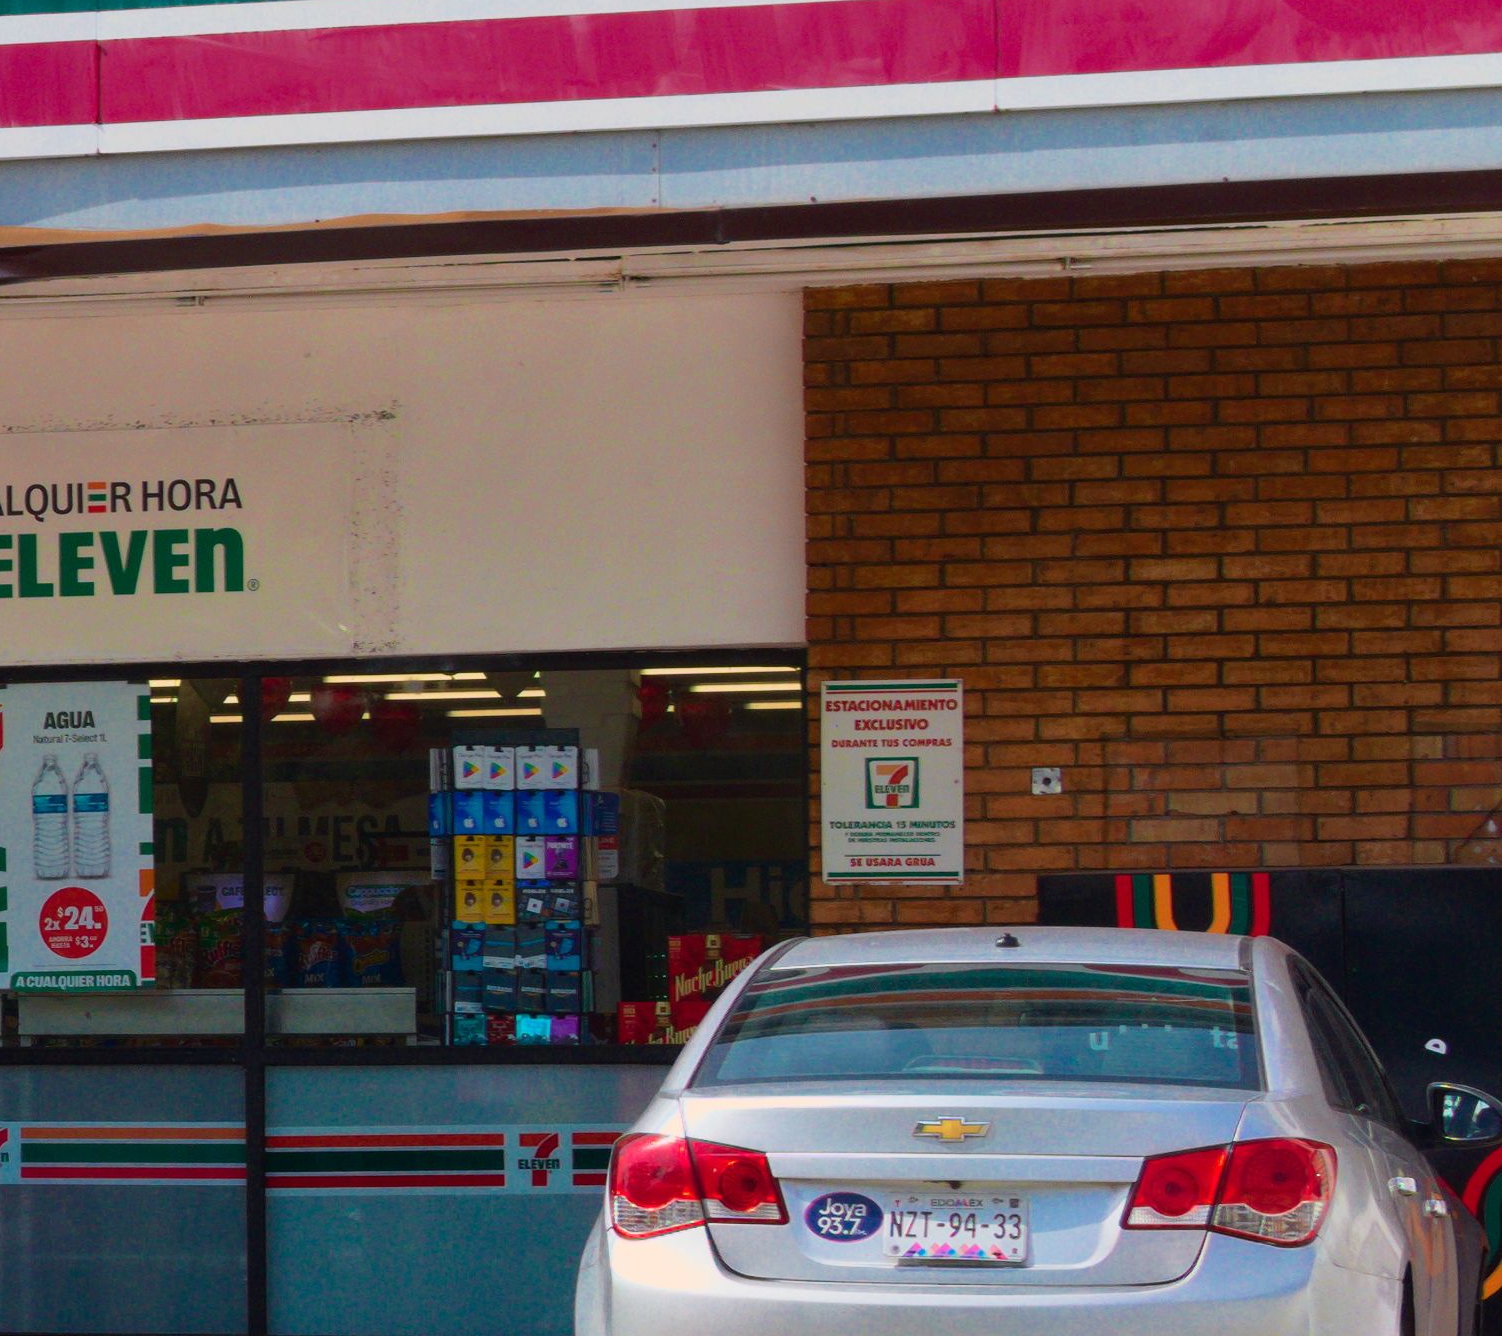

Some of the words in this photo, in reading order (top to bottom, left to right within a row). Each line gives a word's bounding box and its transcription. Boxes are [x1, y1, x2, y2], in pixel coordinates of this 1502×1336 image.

[141, 477, 243, 512] HORA
[824, 699, 958, 712] ESTACIONAMIENTO
[43, 710, 96, 730] AGUA
[854, 718, 929, 731] EXCLUSIVO
[32, 734, 63, 744] Natural
[64, 734, 98, 743] 7-Select
[831, 738, 878, 748] DURANTE
[881, 738, 899, 748] TUS
[902, 738, 953, 747] COMPRAS
[829, 821, 893, 830] TOLERANCIA
[896, 820, 907, 829] 15
[909, 820, 956, 829] MINUTOS
[850, 857, 863, 867] SE
[865, 857, 902, 867] USARA
[905, 857, 936, 866] GRUA
[44, 917, 61, 931] 2x
[15, 976, 26, 987] A
[26, 975, 94, 990] CUALQUIER
[95, 974, 132, 987] HORA
[818, 1197, 867, 1222] Joya
[816, 1216, 862, 1236] 93.7
[889, 1211, 1022, 1240] NZT-94-33
